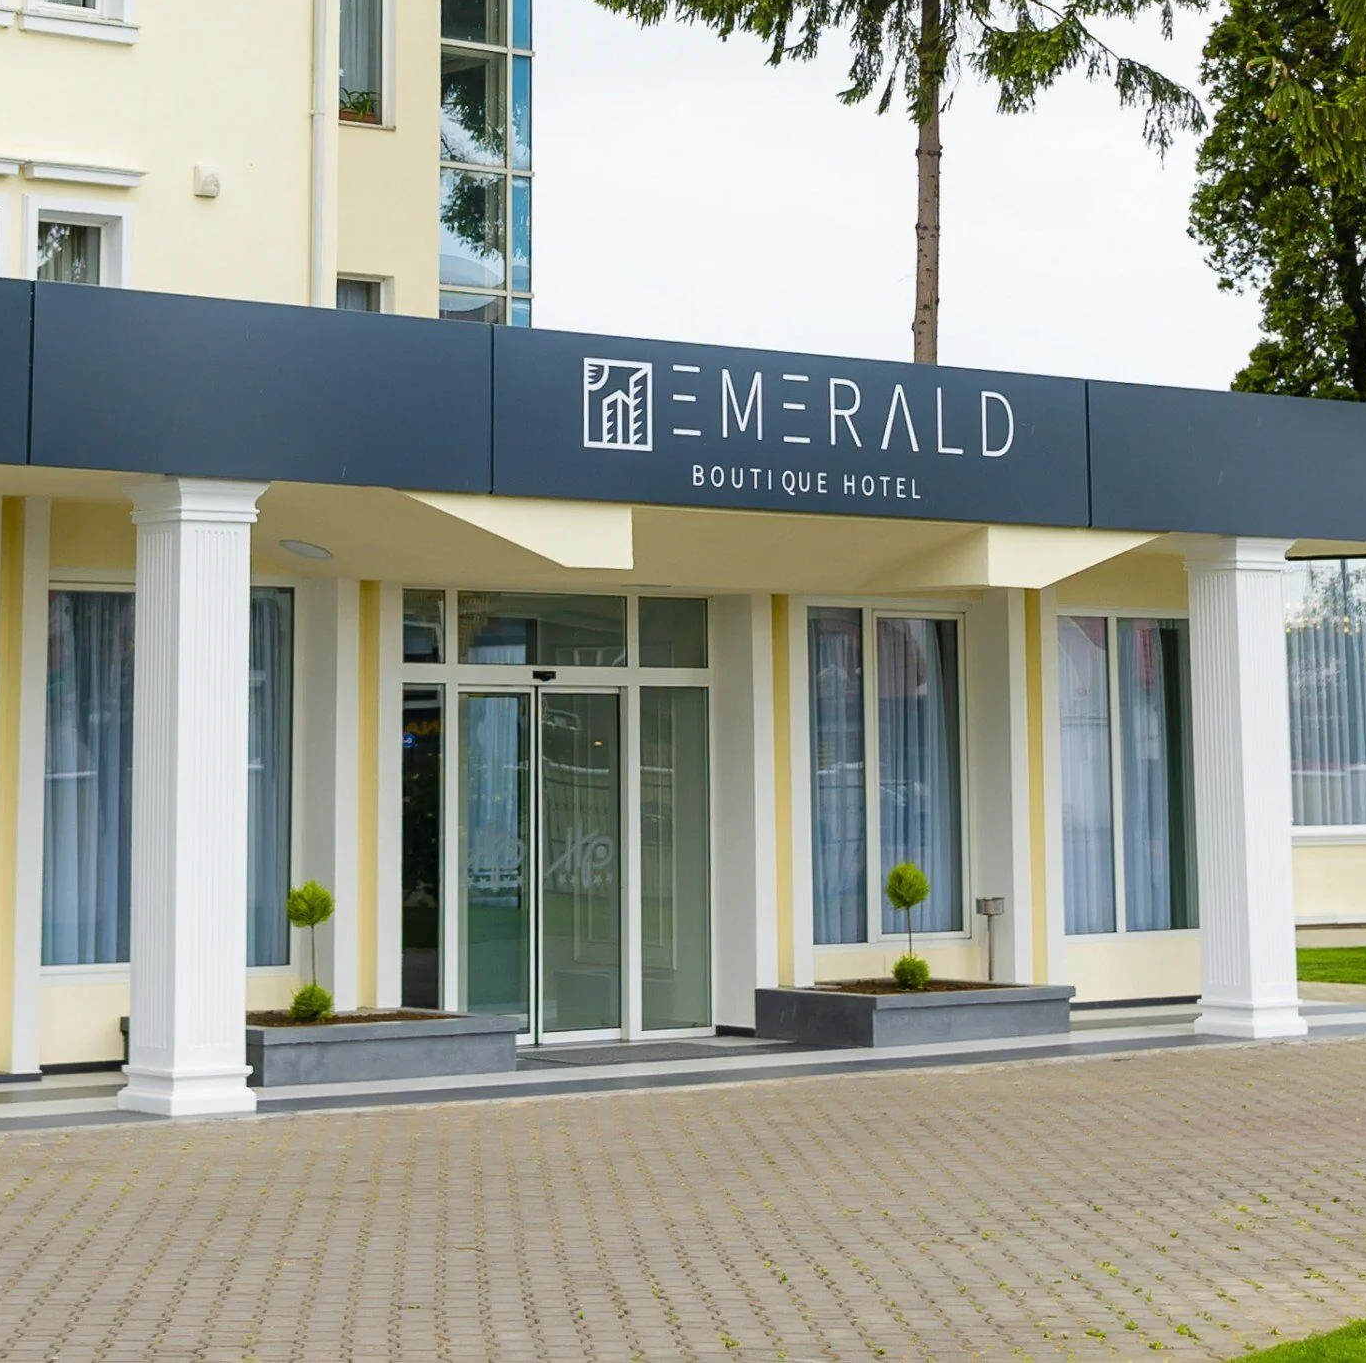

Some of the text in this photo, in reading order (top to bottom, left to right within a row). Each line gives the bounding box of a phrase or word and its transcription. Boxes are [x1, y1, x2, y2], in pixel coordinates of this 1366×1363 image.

[672, 364, 1014, 458] EMERALD
[692, 464, 921, 499] BOUTIQUE HOTEL
